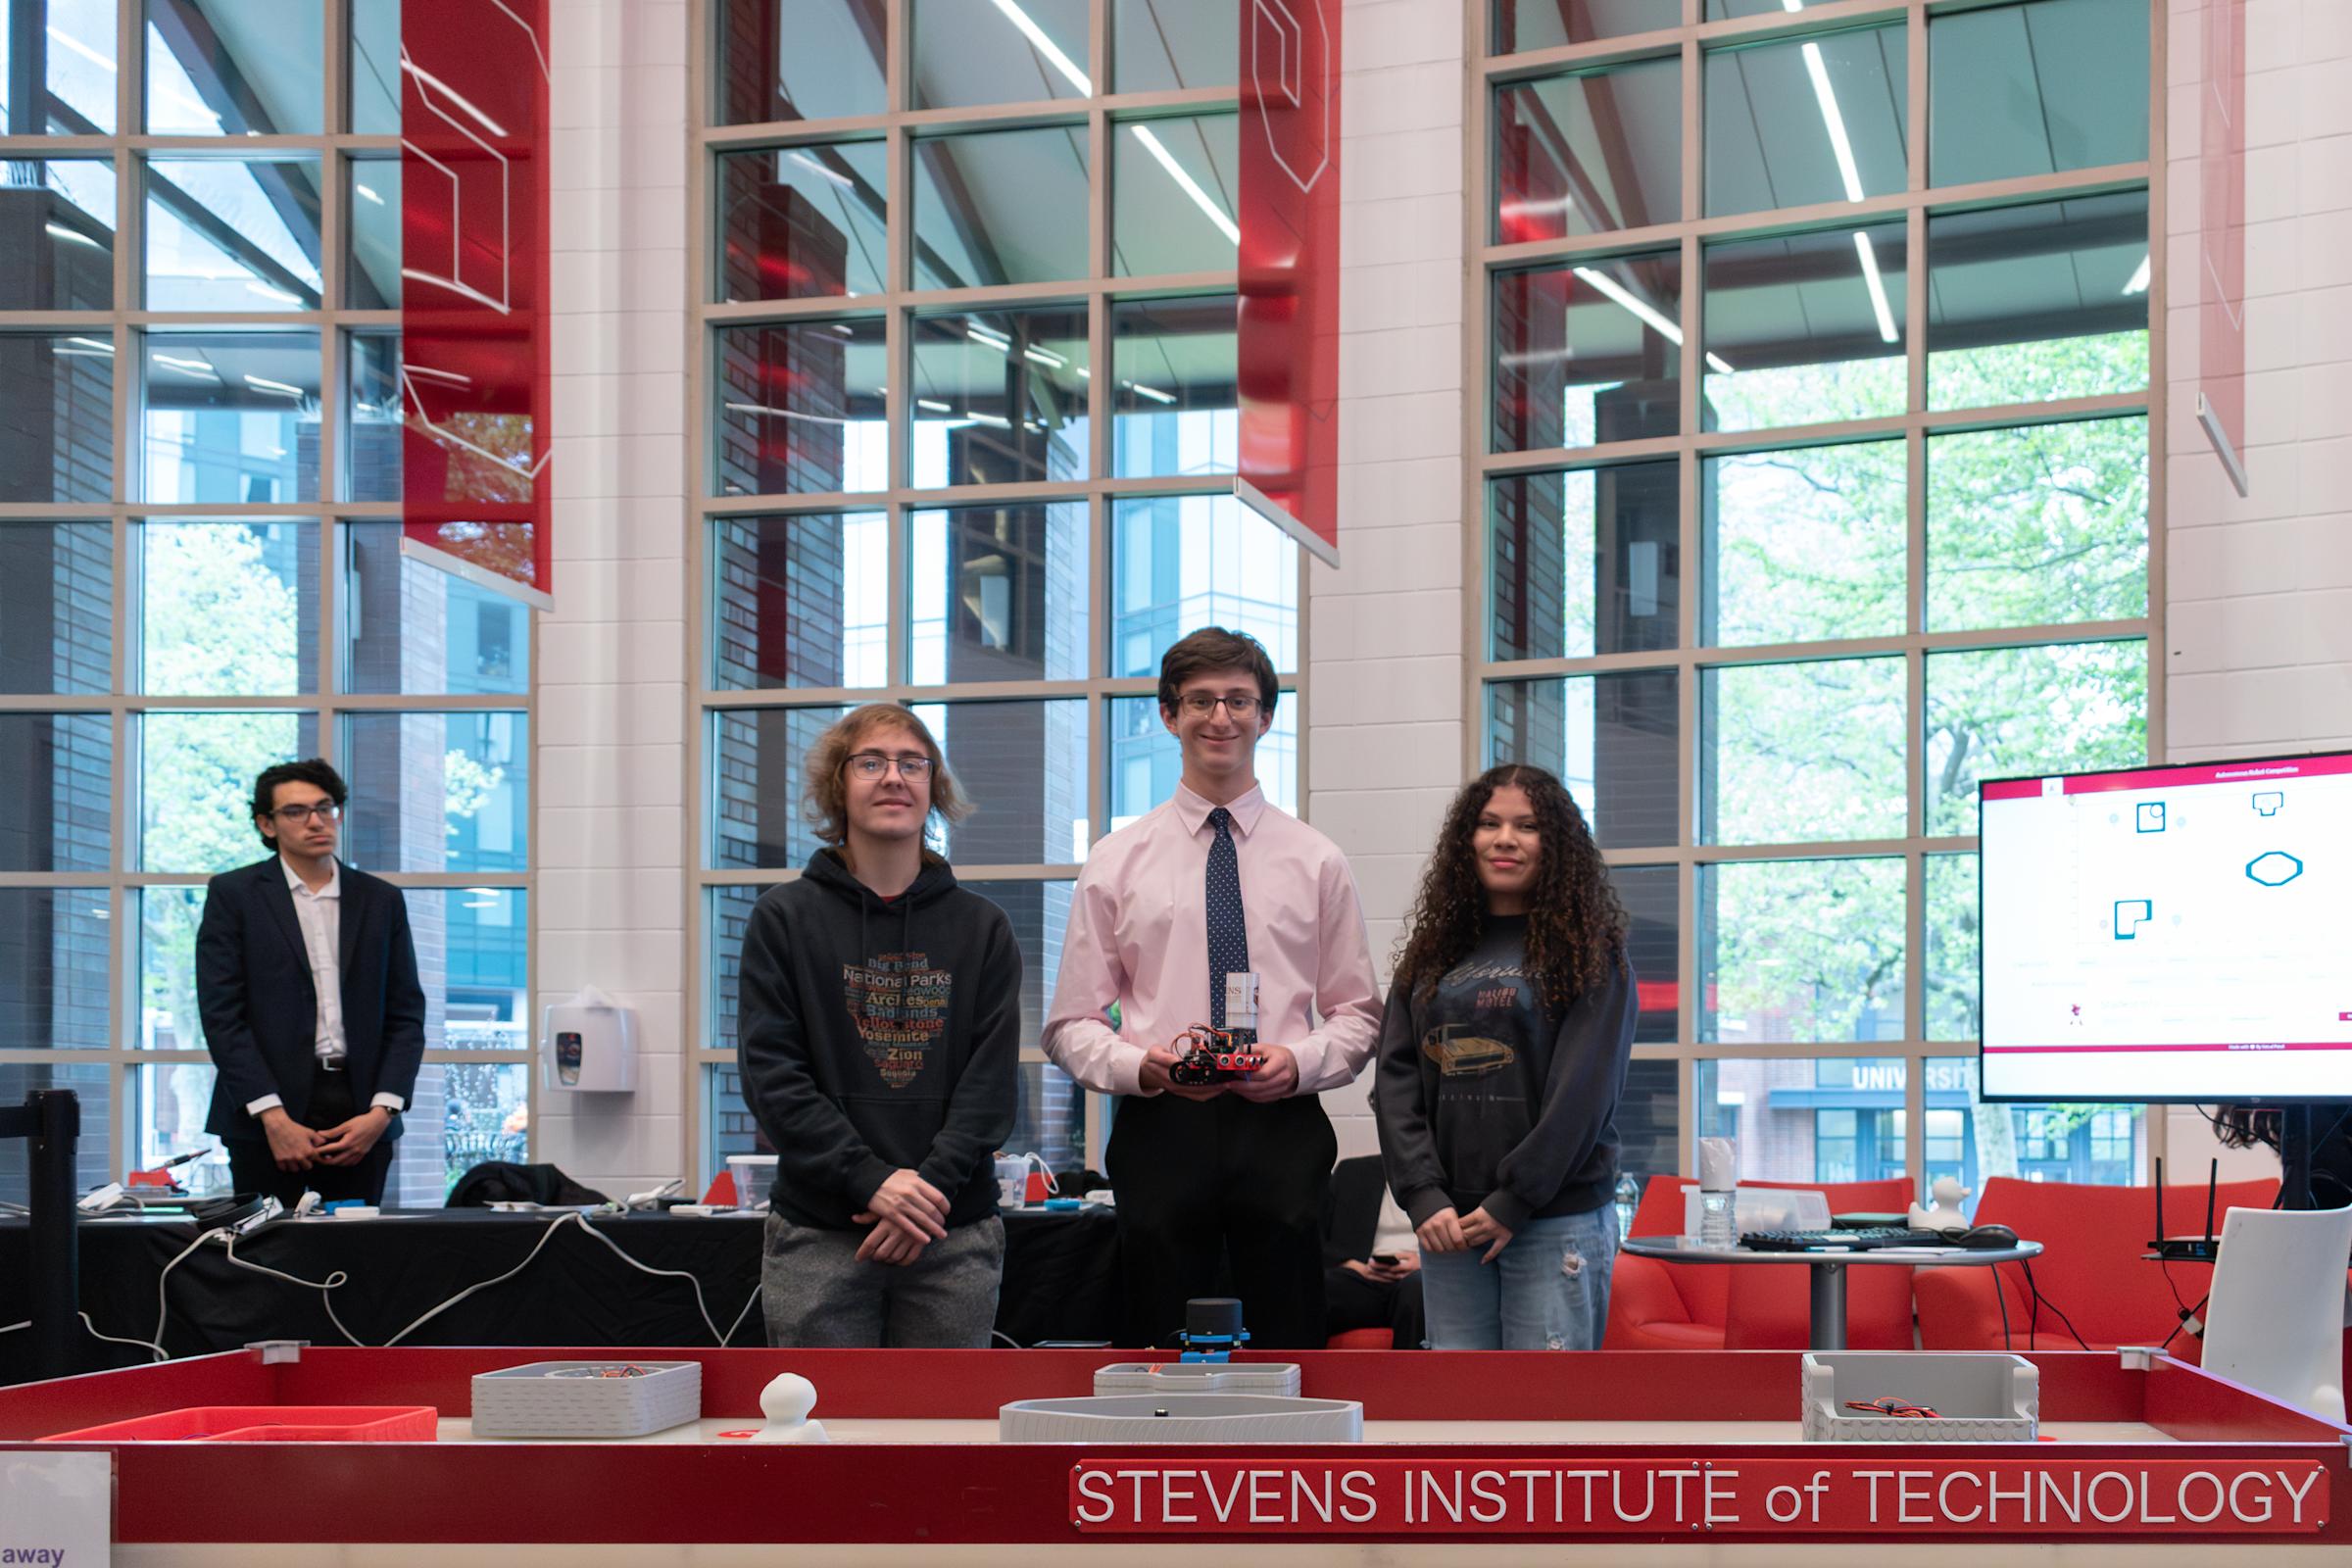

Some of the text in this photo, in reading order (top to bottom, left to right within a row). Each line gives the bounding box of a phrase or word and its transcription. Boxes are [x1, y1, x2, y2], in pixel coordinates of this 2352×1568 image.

[868, 957, 891, 972] Big
[843, 968, 907, 988] National
[910, 973, 953, 986] Parks
[1476, 997, 1514, 1007] MOTEL
[857, 1025, 930, 1043] Yosemite
[887, 1047, 923, 1060] Zion
[1852, 1066, 1973, 1090] UNIVRSIT
[1077, 1470, 2320, 1523] STEVENS INSTITUTE of TECHNOLOGY
[2, 1548, 65, 1568] away
